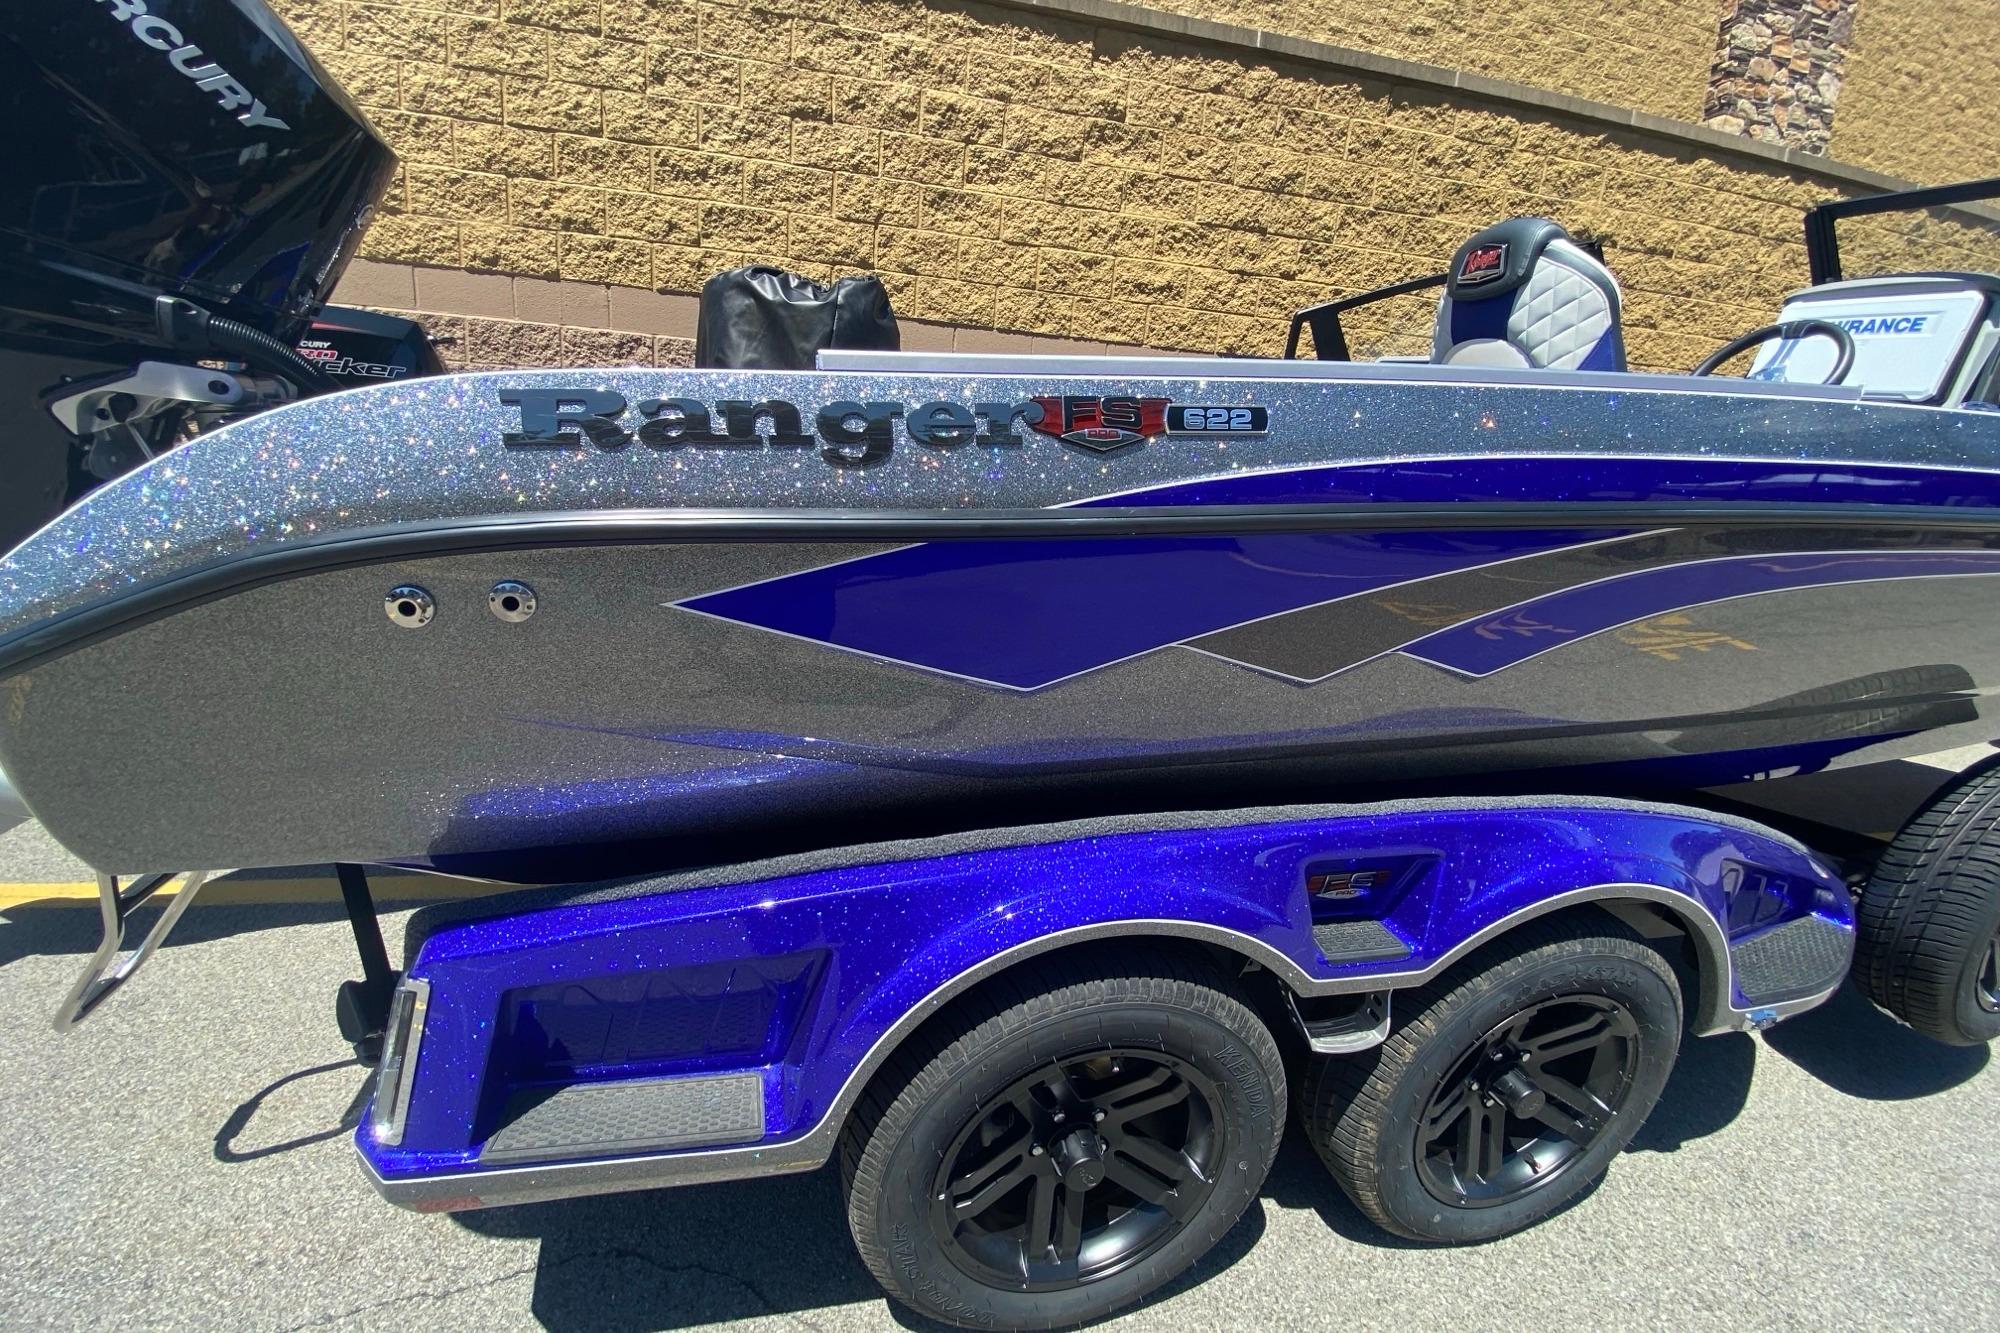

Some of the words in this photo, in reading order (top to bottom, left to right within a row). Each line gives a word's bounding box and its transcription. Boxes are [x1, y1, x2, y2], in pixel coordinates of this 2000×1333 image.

[314, 357, 407, 379] cker
[500, 388, 1045, 468] Ranger
[1062, 395, 1143, 431] FS
[1183, 408, 1252, 430] 622
[1321, 871, 1377, 896] FS
[1214, 1044, 1269, 1118] KENDA
